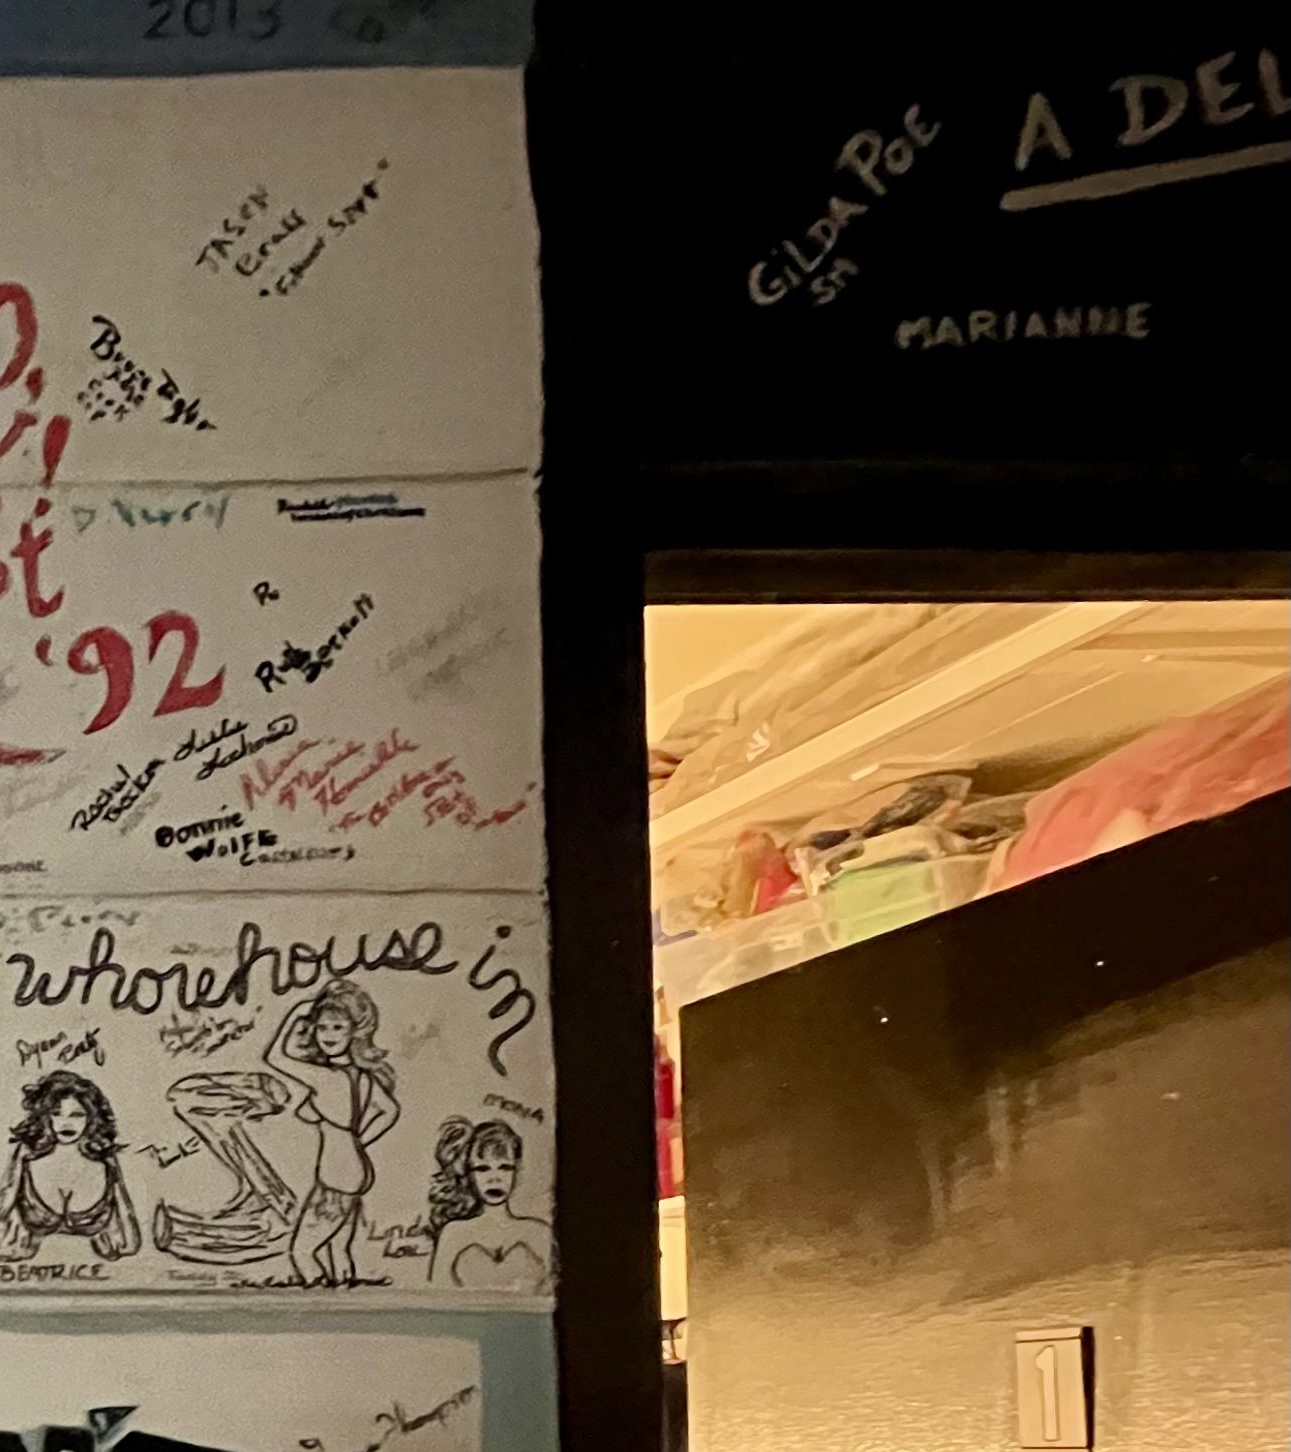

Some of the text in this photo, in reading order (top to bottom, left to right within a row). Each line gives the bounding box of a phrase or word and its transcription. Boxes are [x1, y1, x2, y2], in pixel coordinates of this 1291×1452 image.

[1014, 90, 1073, 172] A
[894, 301, 1153, 350] MARIANNE
[7, 921, 460, 1016] whorehouse
